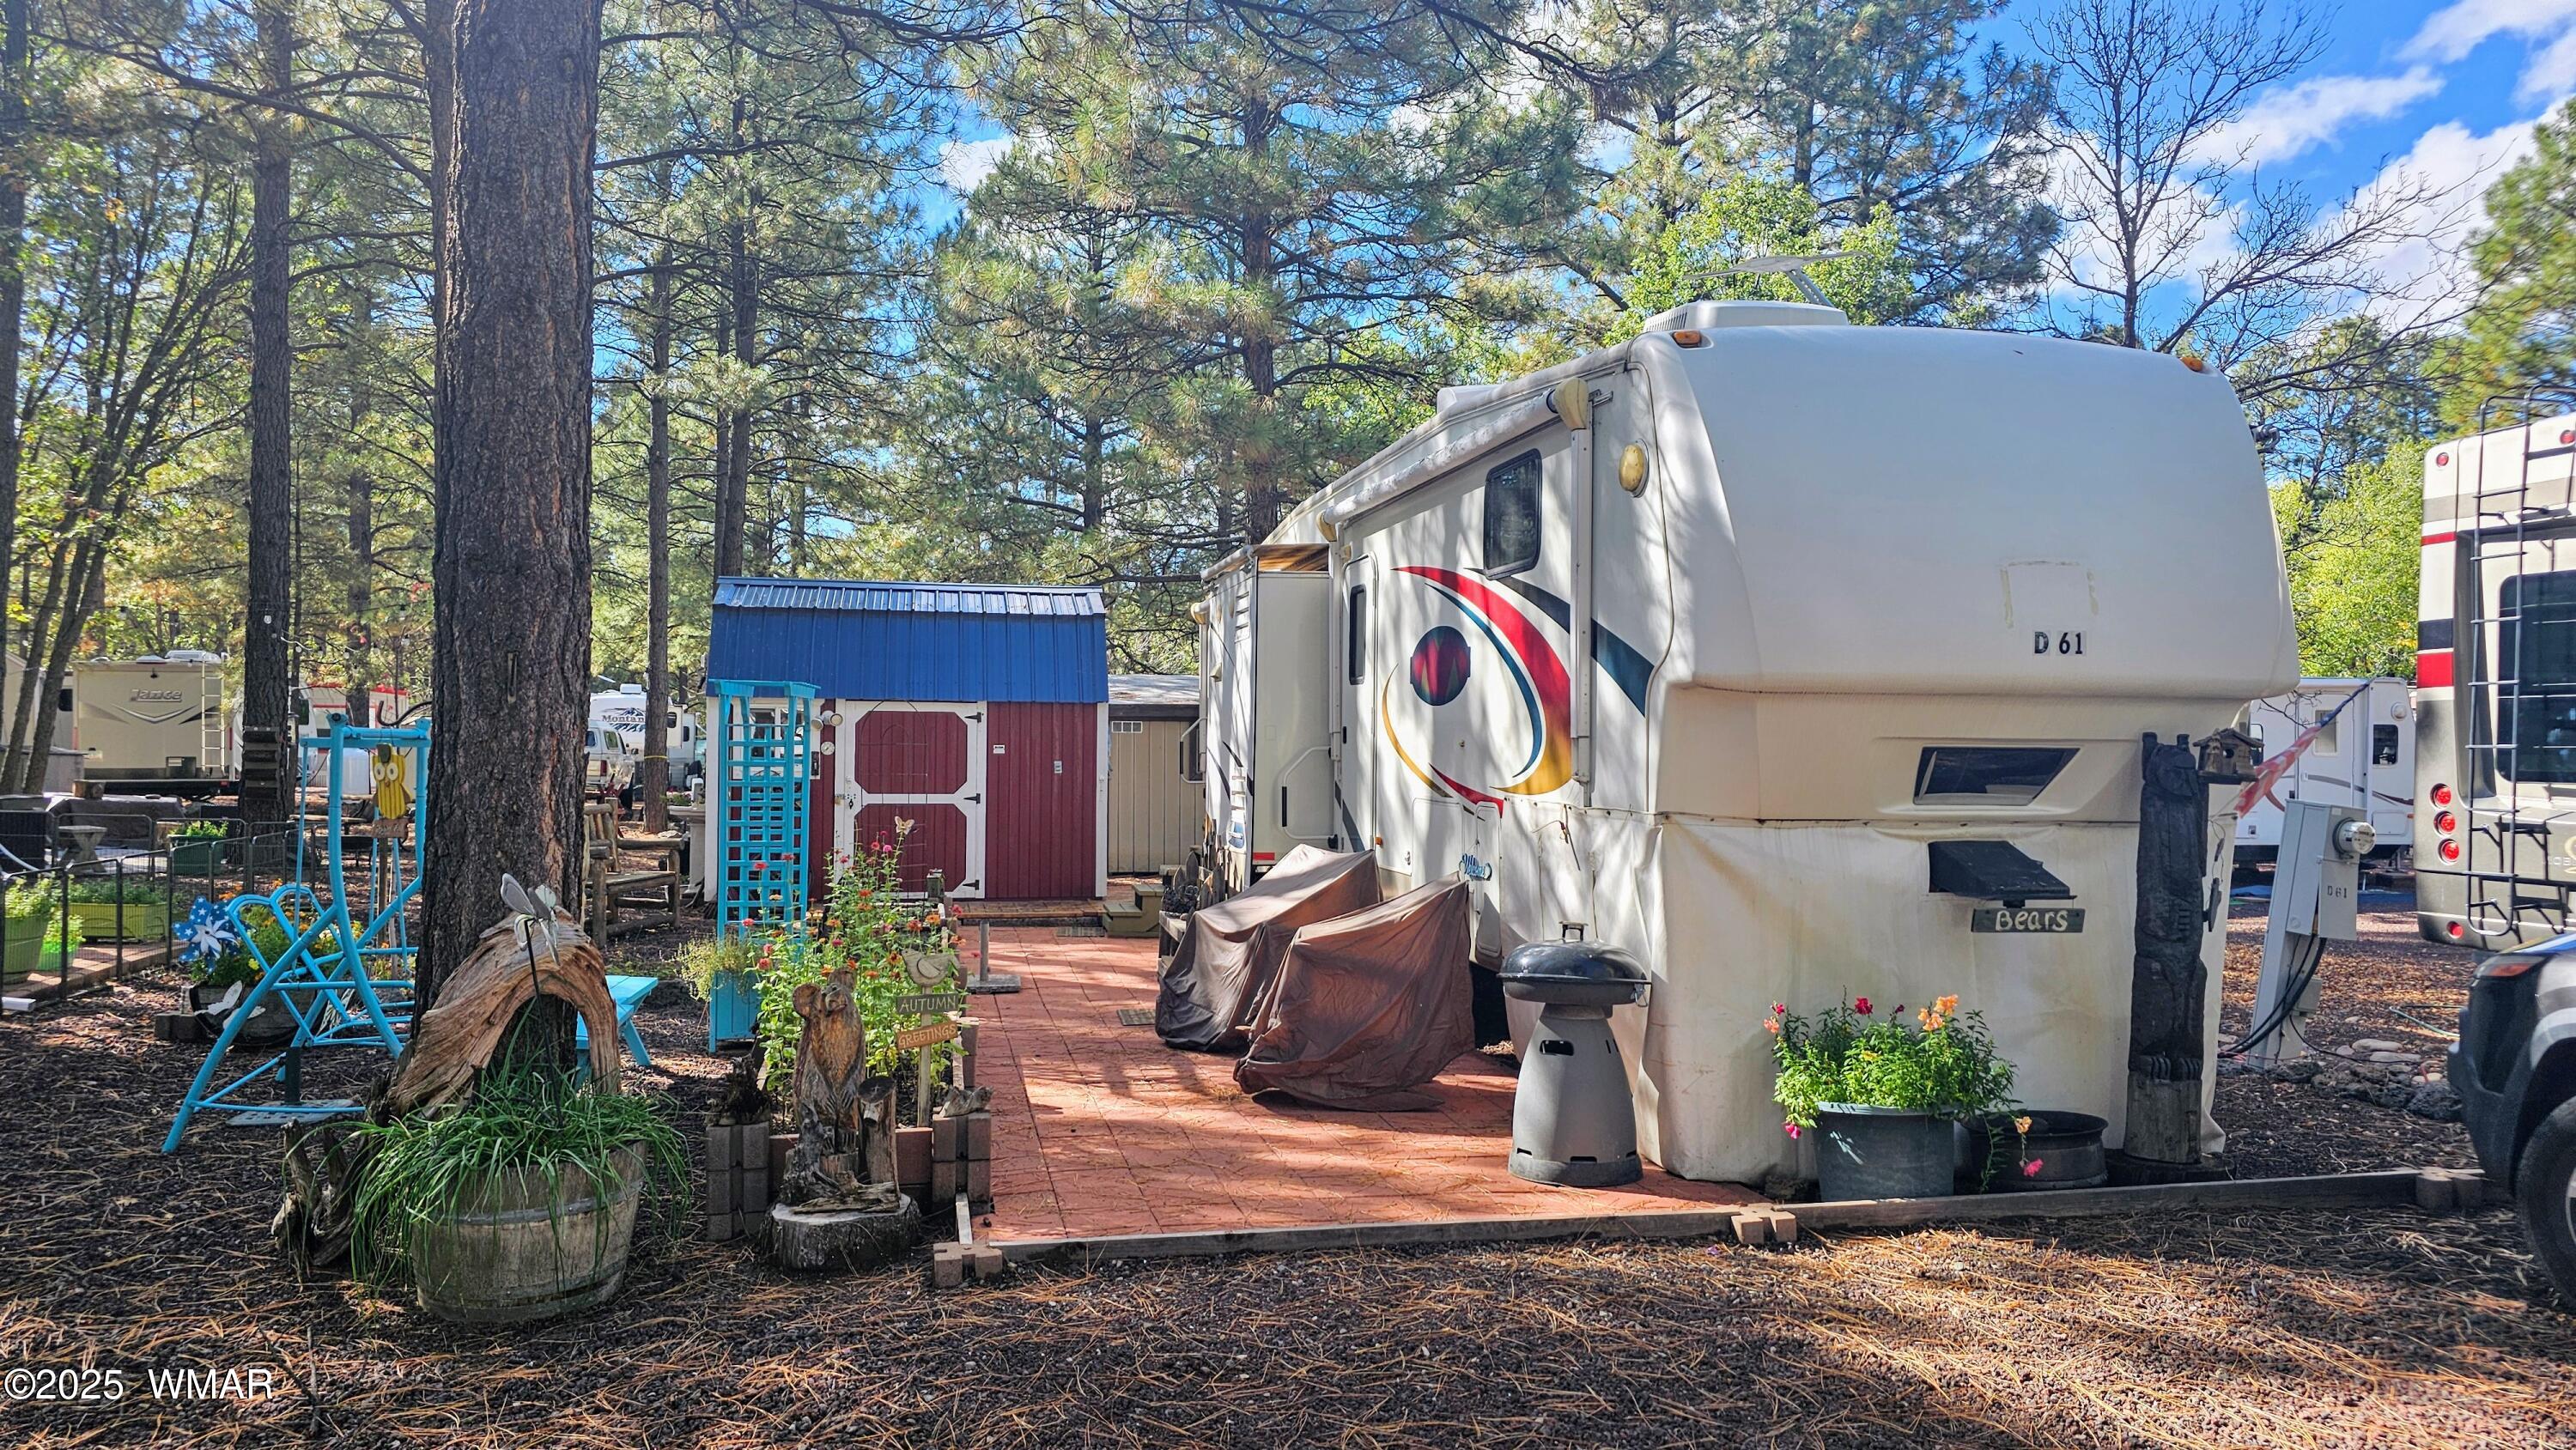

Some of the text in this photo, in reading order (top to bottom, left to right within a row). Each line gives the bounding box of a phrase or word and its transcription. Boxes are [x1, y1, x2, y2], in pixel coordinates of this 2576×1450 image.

[2034, 631, 2083, 655] D 61
[602, 714, 645, 723] Montan
[1995, 909, 2069, 932] Bears
[899, 995, 957, 1013] AUTUMN
[898, 1023, 957, 1048] GREETINGS
